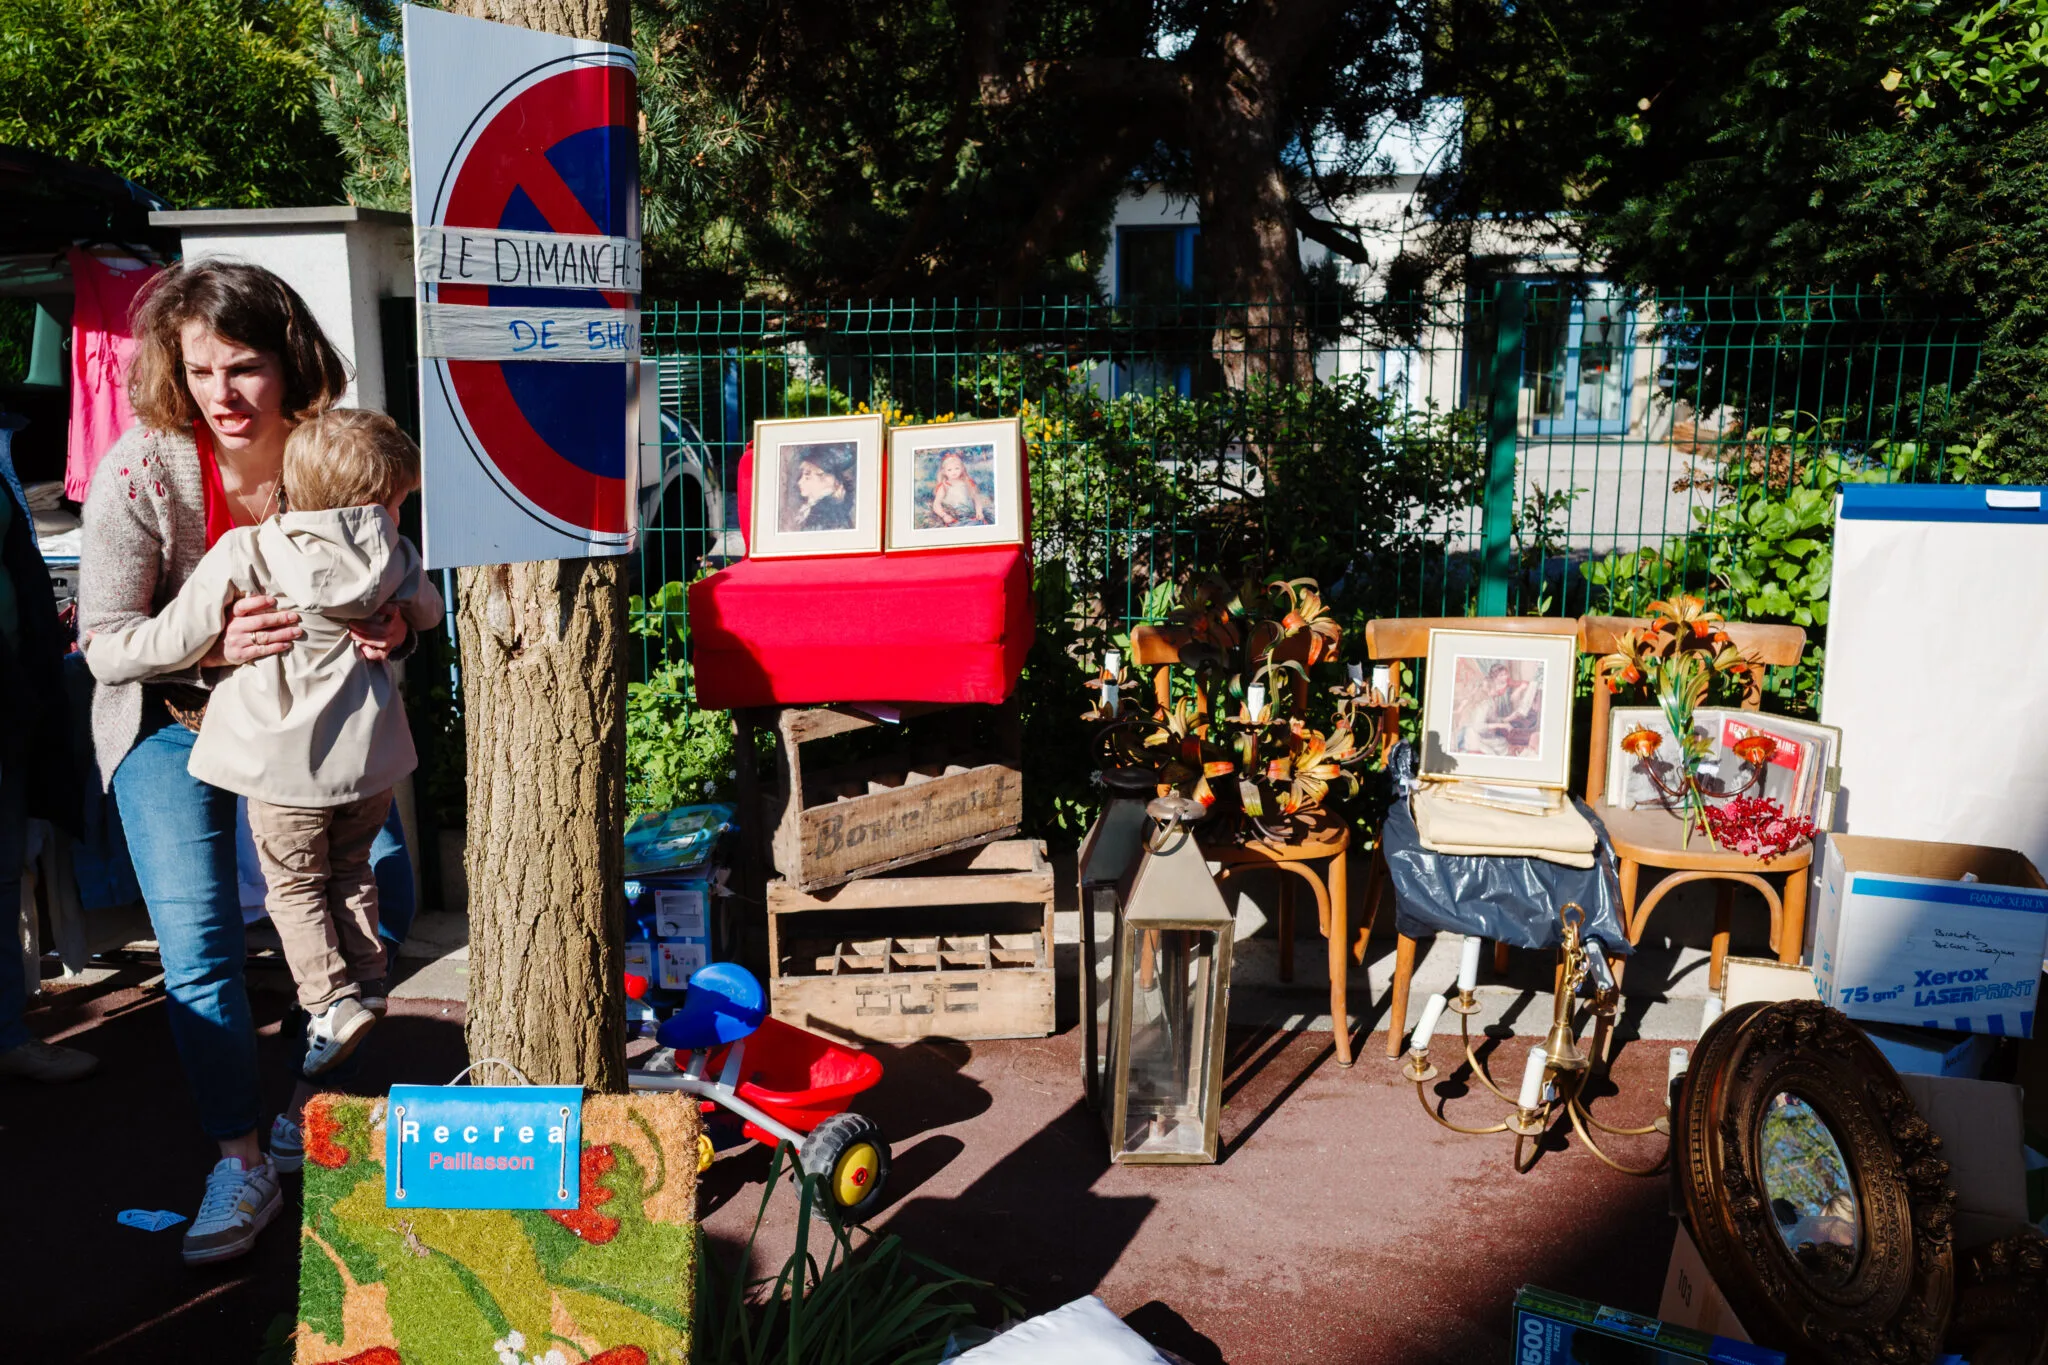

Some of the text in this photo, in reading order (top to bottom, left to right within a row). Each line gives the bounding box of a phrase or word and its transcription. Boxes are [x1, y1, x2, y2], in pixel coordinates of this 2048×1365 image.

[439, 233, 473, 280] LE
[494, 238, 631, 287] DIMANCHE
[509, 319, 559, 352] DE
[1969, 892, 2008, 906] RANK
[1914, 967, 1989, 988] Xerox
[1840, 986, 1870, 1004] 75
[401, 1120, 563, 1144] Recrea
[429, 1152, 535, 1170] Paillasson
